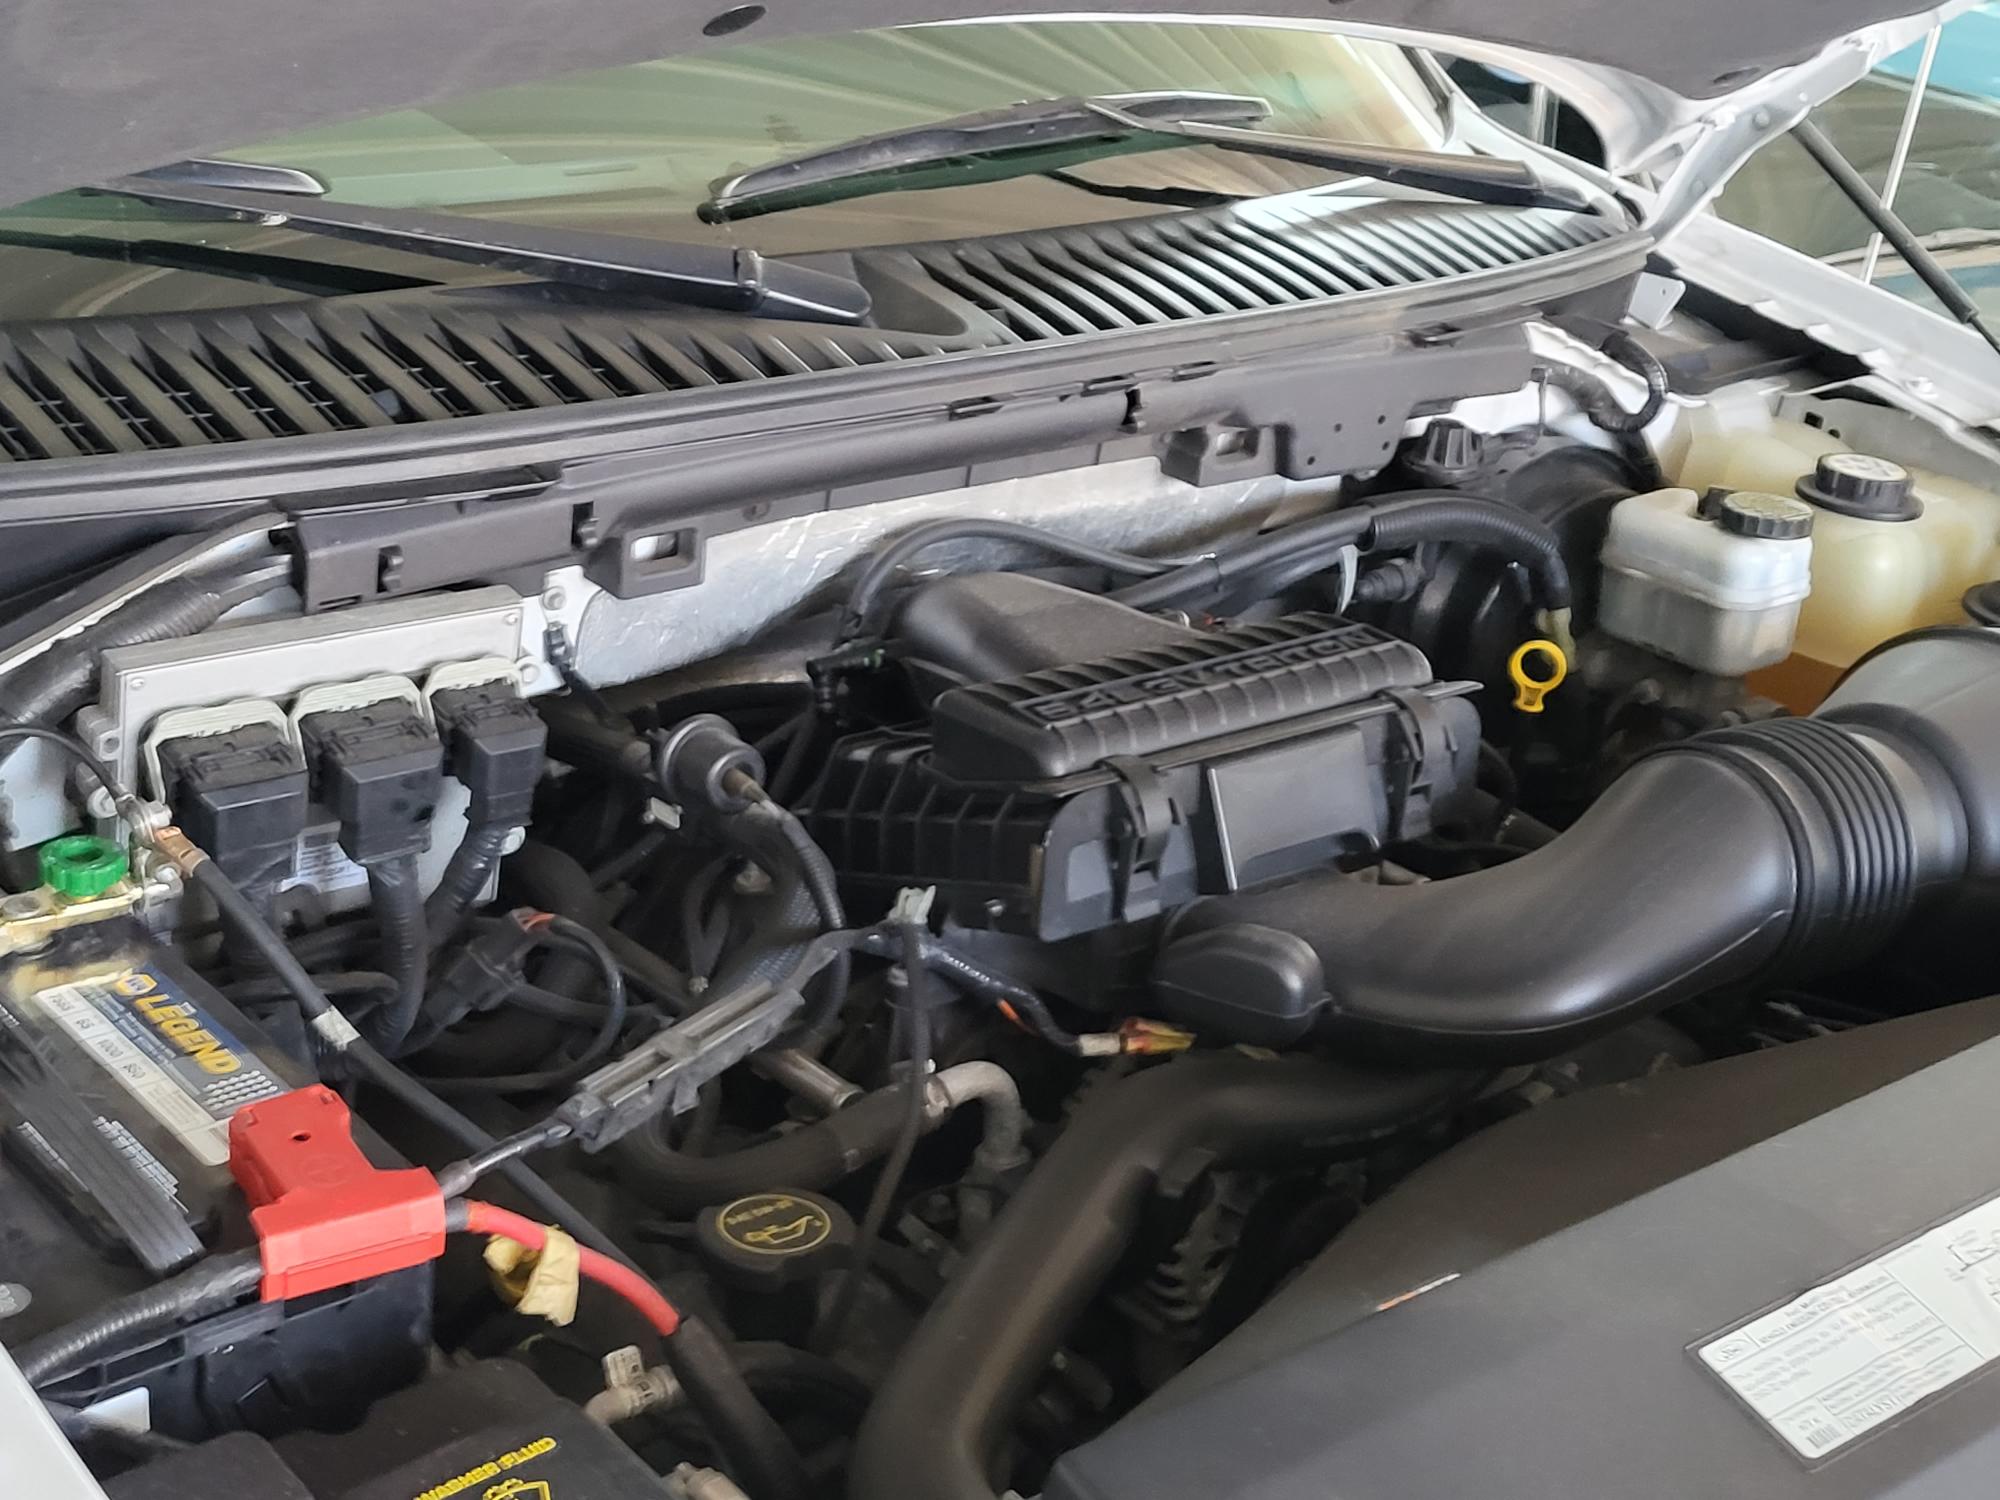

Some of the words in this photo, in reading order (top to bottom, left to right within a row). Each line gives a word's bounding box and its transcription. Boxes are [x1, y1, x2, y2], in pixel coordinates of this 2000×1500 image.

[1213, 628, 1382, 676] TRITON
[134, 993, 242, 1075] LEGEND
[412, 1461, 501, 1500] WASHER
[498, 1437, 558, 1470] FLUID
